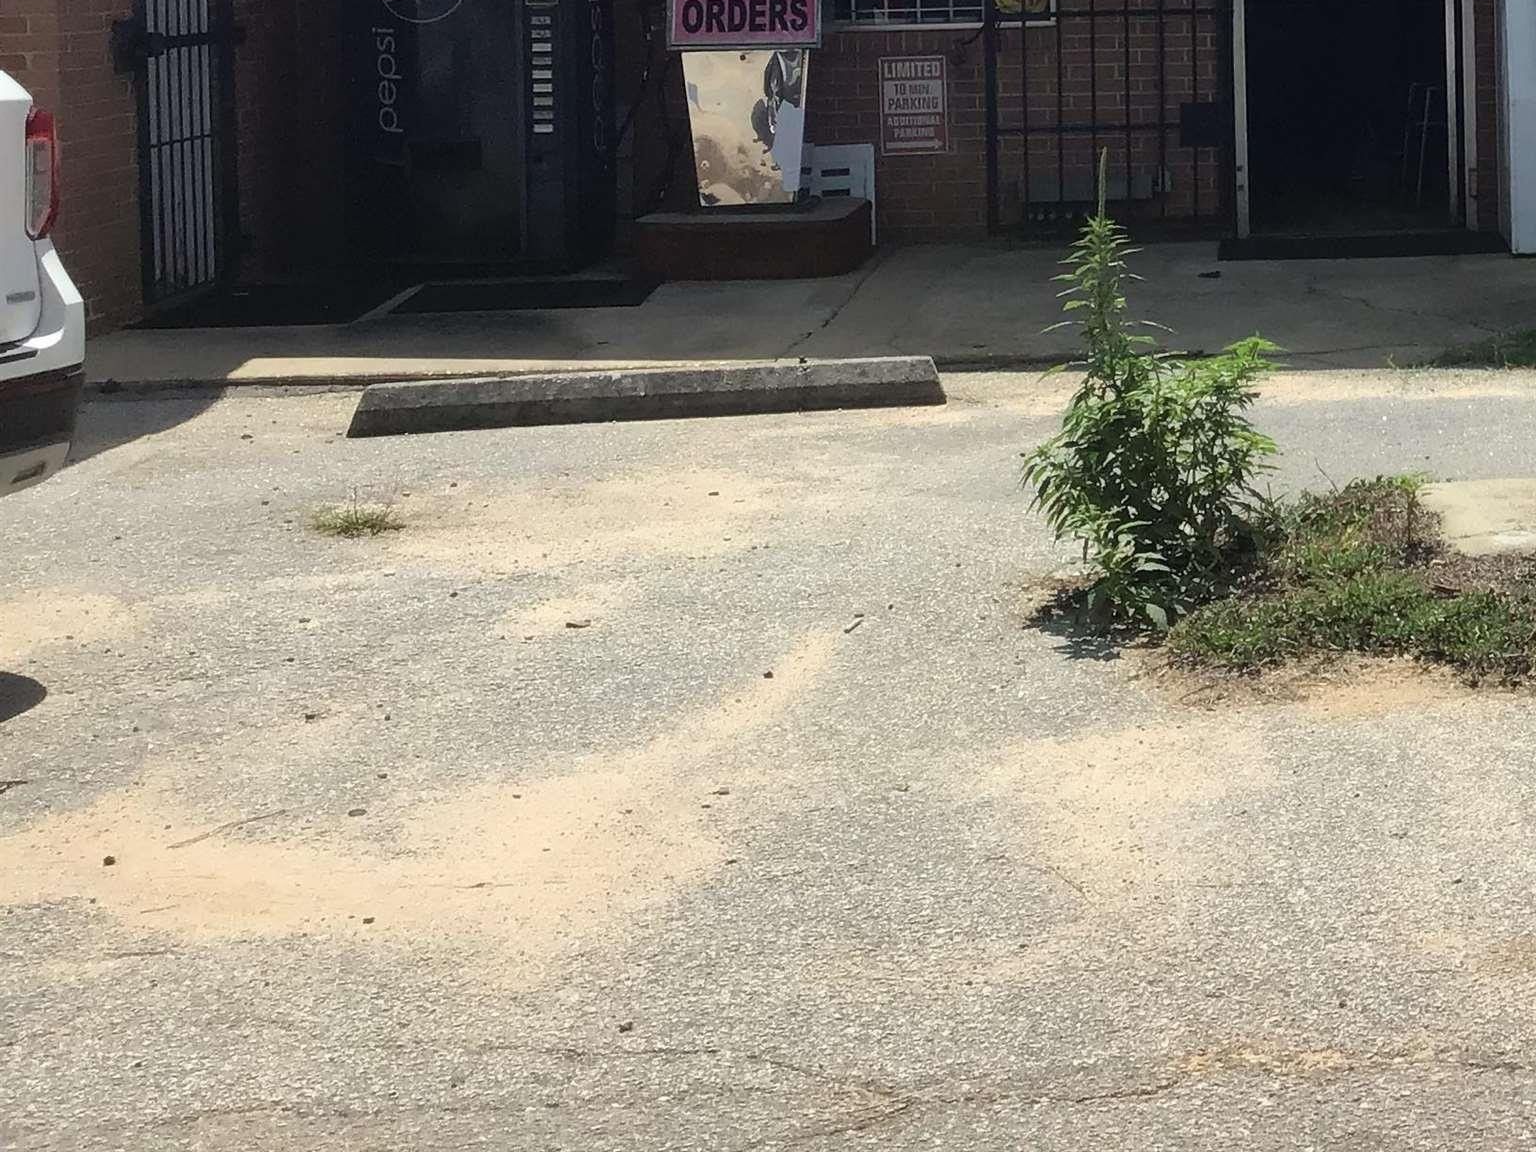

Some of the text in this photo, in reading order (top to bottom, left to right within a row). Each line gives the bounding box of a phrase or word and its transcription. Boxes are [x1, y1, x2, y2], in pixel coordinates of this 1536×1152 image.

[883, 61, 941, 79] LIMITED
[372, 26, 403, 133] pepsi
[887, 96, 940, 111] PARKING
